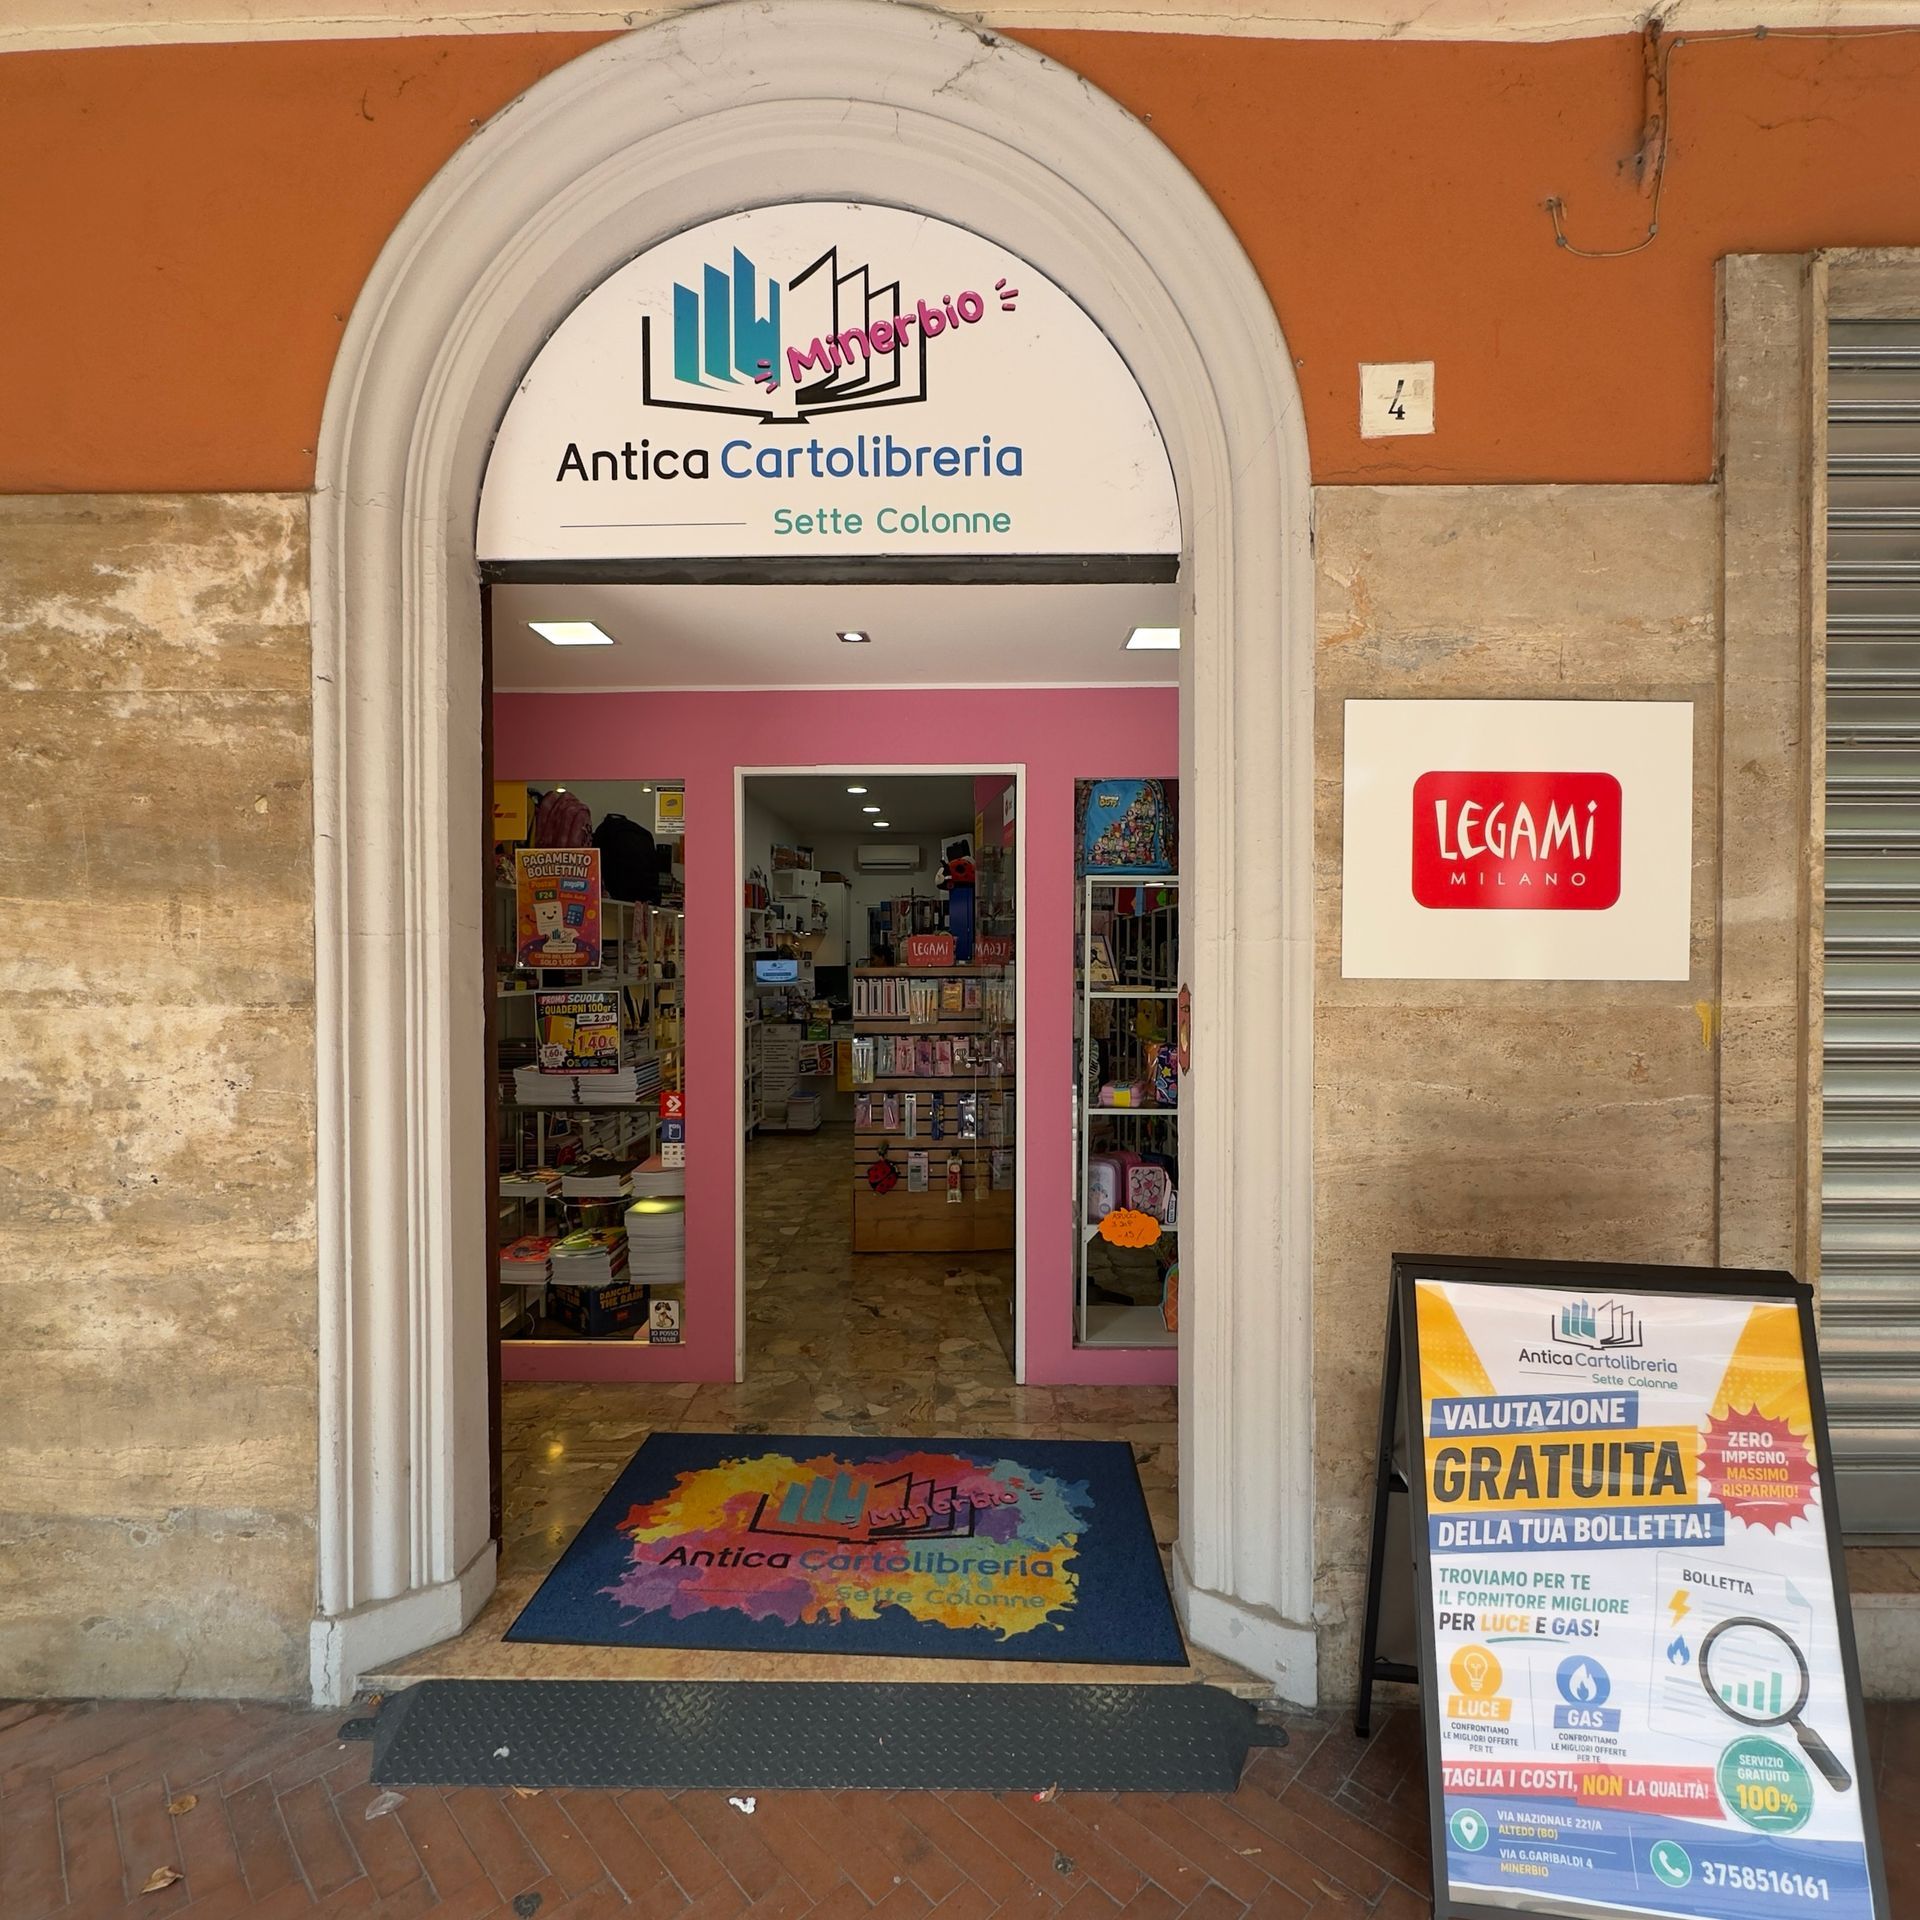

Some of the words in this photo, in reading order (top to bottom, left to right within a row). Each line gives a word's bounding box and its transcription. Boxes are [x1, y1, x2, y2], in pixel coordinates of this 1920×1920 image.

[787, 289, 985, 385] Minerbio
[1388, 379, 1406, 421] 4
[556, 438, 709, 483] Antica
[720, 434, 1023, 478] Cartolibreria
[773, 507, 863, 536] Sette
[876, 505, 1012, 535] Colonne
[523, 852, 592, 867] PAGAMENTO
[527, 865, 589, 878] BOLLETTINI
[1450, 872, 1587, 887] MILANO
[567, 993, 605, 1003] SCUOLA
[545, 1004, 587, 1015] QUADERNI
[1518, 1348, 1573, 1366] Antica
[1575, 1352, 1678, 1374] Cartolibreria
[1592, 1373, 1624, 1387] Sette
[1628, 1376, 1678, 1390] Colonne
[1442, 1398, 1626, 1431] VALUTAZIONE
[1727, 1431, 1773, 1448] ZERO
[1721, 1450, 1789, 1466] IMPEGNO,
[1433, 1440, 1688, 1503] GRATUITA
[1727, 1467, 1789, 1482] MASSIMO
[1722, 1484, 1799, 1499] RISPARMIO!
[868, 1489, 1020, 1527] Minerbio
[1438, 1518, 1513, 1547] DELLA
[1518, 1517, 1566, 1545] TUA
[1574, 1512, 1712, 1543] BOLLETTA!
[659, 1545, 792, 1570] Antica
[799, 1547, 1055, 1578] Cartolibreria
[1439, 1567, 1528, 1588] TROVIAMO
[1533, 1573, 1565, 1589] PER
[1571, 1574, 1591, 1591] TE
[1683, 1568, 1754, 1596] BOLLETTA
[835, 1584, 915, 1606] Sette
[925, 1588, 1047, 1610] Colonne
[1439, 1590, 1453, 1606] IL
[1457, 1591, 1547, 1610] FORNITORE
[1551, 1596, 1630, 1615] MIGLIORE
[1439, 1612, 1475, 1632] PER
[1481, 1614, 1530, 1633] LUCE
[1535, 1617, 1546, 1634] E
[1552, 1617, 1600, 1637] GAS!
[1457, 1699, 1500, 1718] LUCE
[1451, 1721, 1509, 1735] CONFRONTIAMO
[1567, 1709, 1604, 1729] GAS
[1443, 1731, 1452, 1740] LE
[1453, 1732, 1486, 1744] MIGLIORI
[1487, 1736, 1519, 1747] OFFERTE
[1469, 1743, 1483, 1752] PER
[1484, 1745, 1493, 1754] TE
[1558, 1732, 1618, 1746] CONFRONTIAMO
[1551, 1742, 1560, 1751] LE
[1561, 1743, 1594, 1754] MIGLIORI
[1594, 1746, 1627, 1757] OFFERTE
[1577, 1754, 1591, 1763] PER
[1592, 1755, 1601, 1764] TE
[1738, 1753, 1784, 1769] SERVIZIO
[1443, 1767, 1505, 1788] TAGLIA
[1509, 1769, 1516, 1788] I
[1520, 1769, 1579, 1793] COSTI,
[1582, 1774, 1623, 1797] NON
[1628, 1780, 1646, 1797] LA
[1649, 1778, 1709, 1800] QUALITÀ!
[1737, 1767, 1791, 1784] GRATUITO
[1736, 1783, 1799, 1814] 100%
[1497, 1810, 1515, 1822] VIA
[1516, 1812, 1573, 1828] NAZIONALE
[1575, 1818, 1603, 1831] 221/A
[1498, 1824, 1535, 1837] ALTEDO
[1537, 1828, 1559, 1841] (BO)
[1499, 1848, 1517, 1860] VIA
[1519, 1849, 1584, 1868] G.GARIBALDI
[1585, 1858, 1593, 1869] 4
[1500, 1862, 1550, 1878] MINERBIO
[1701, 1860, 1830, 1902] 3758516161
